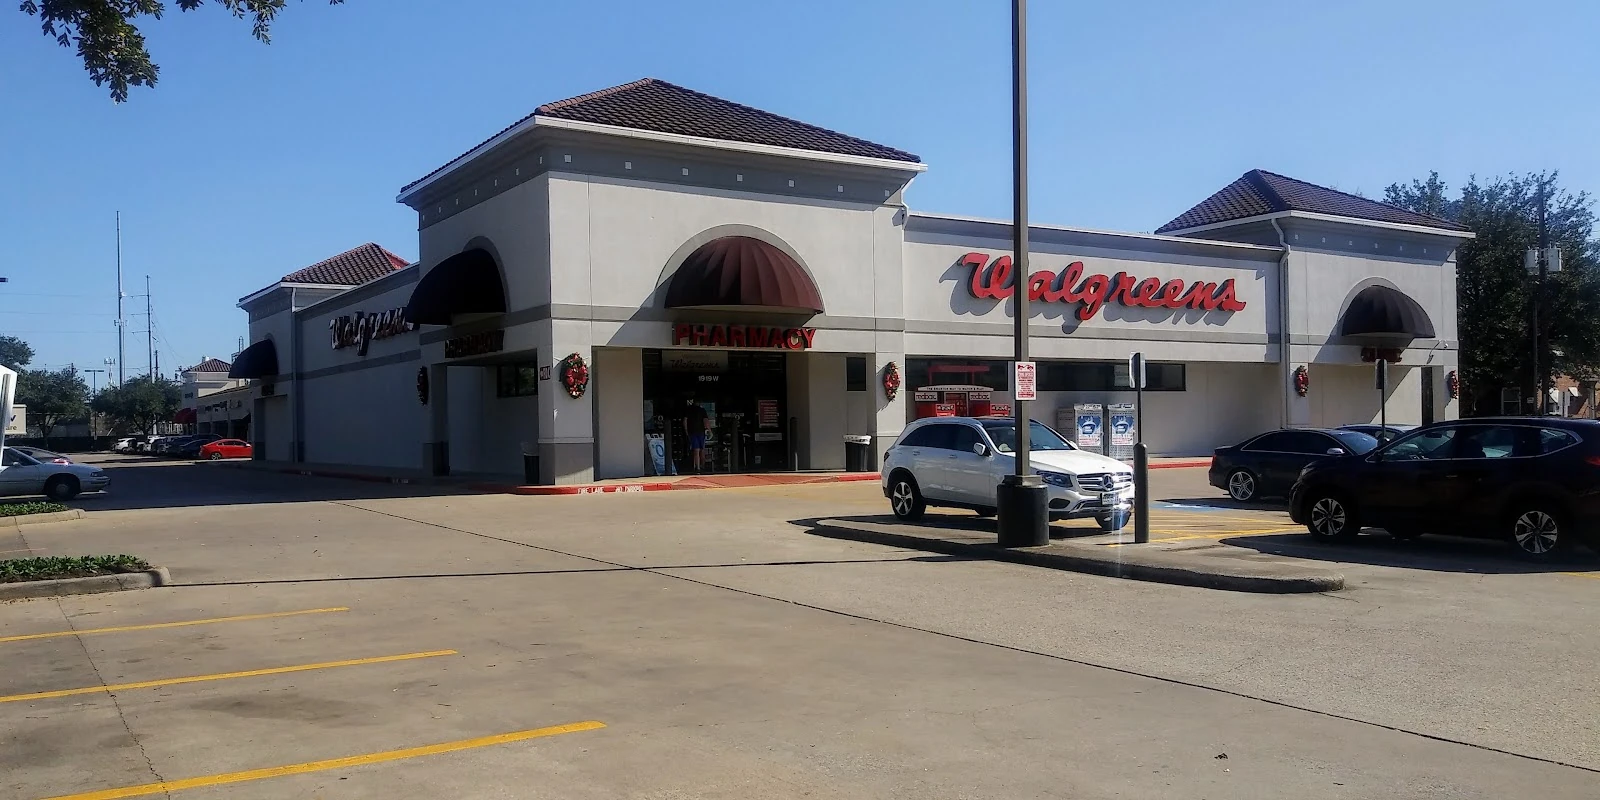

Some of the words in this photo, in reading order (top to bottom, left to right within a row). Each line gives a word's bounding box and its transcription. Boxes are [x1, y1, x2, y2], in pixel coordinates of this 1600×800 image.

[960, 252, 1246, 321] Walgreens
[672, 323, 817, 350] PHARMACY
[670, 358, 720, 370] Walgreens
